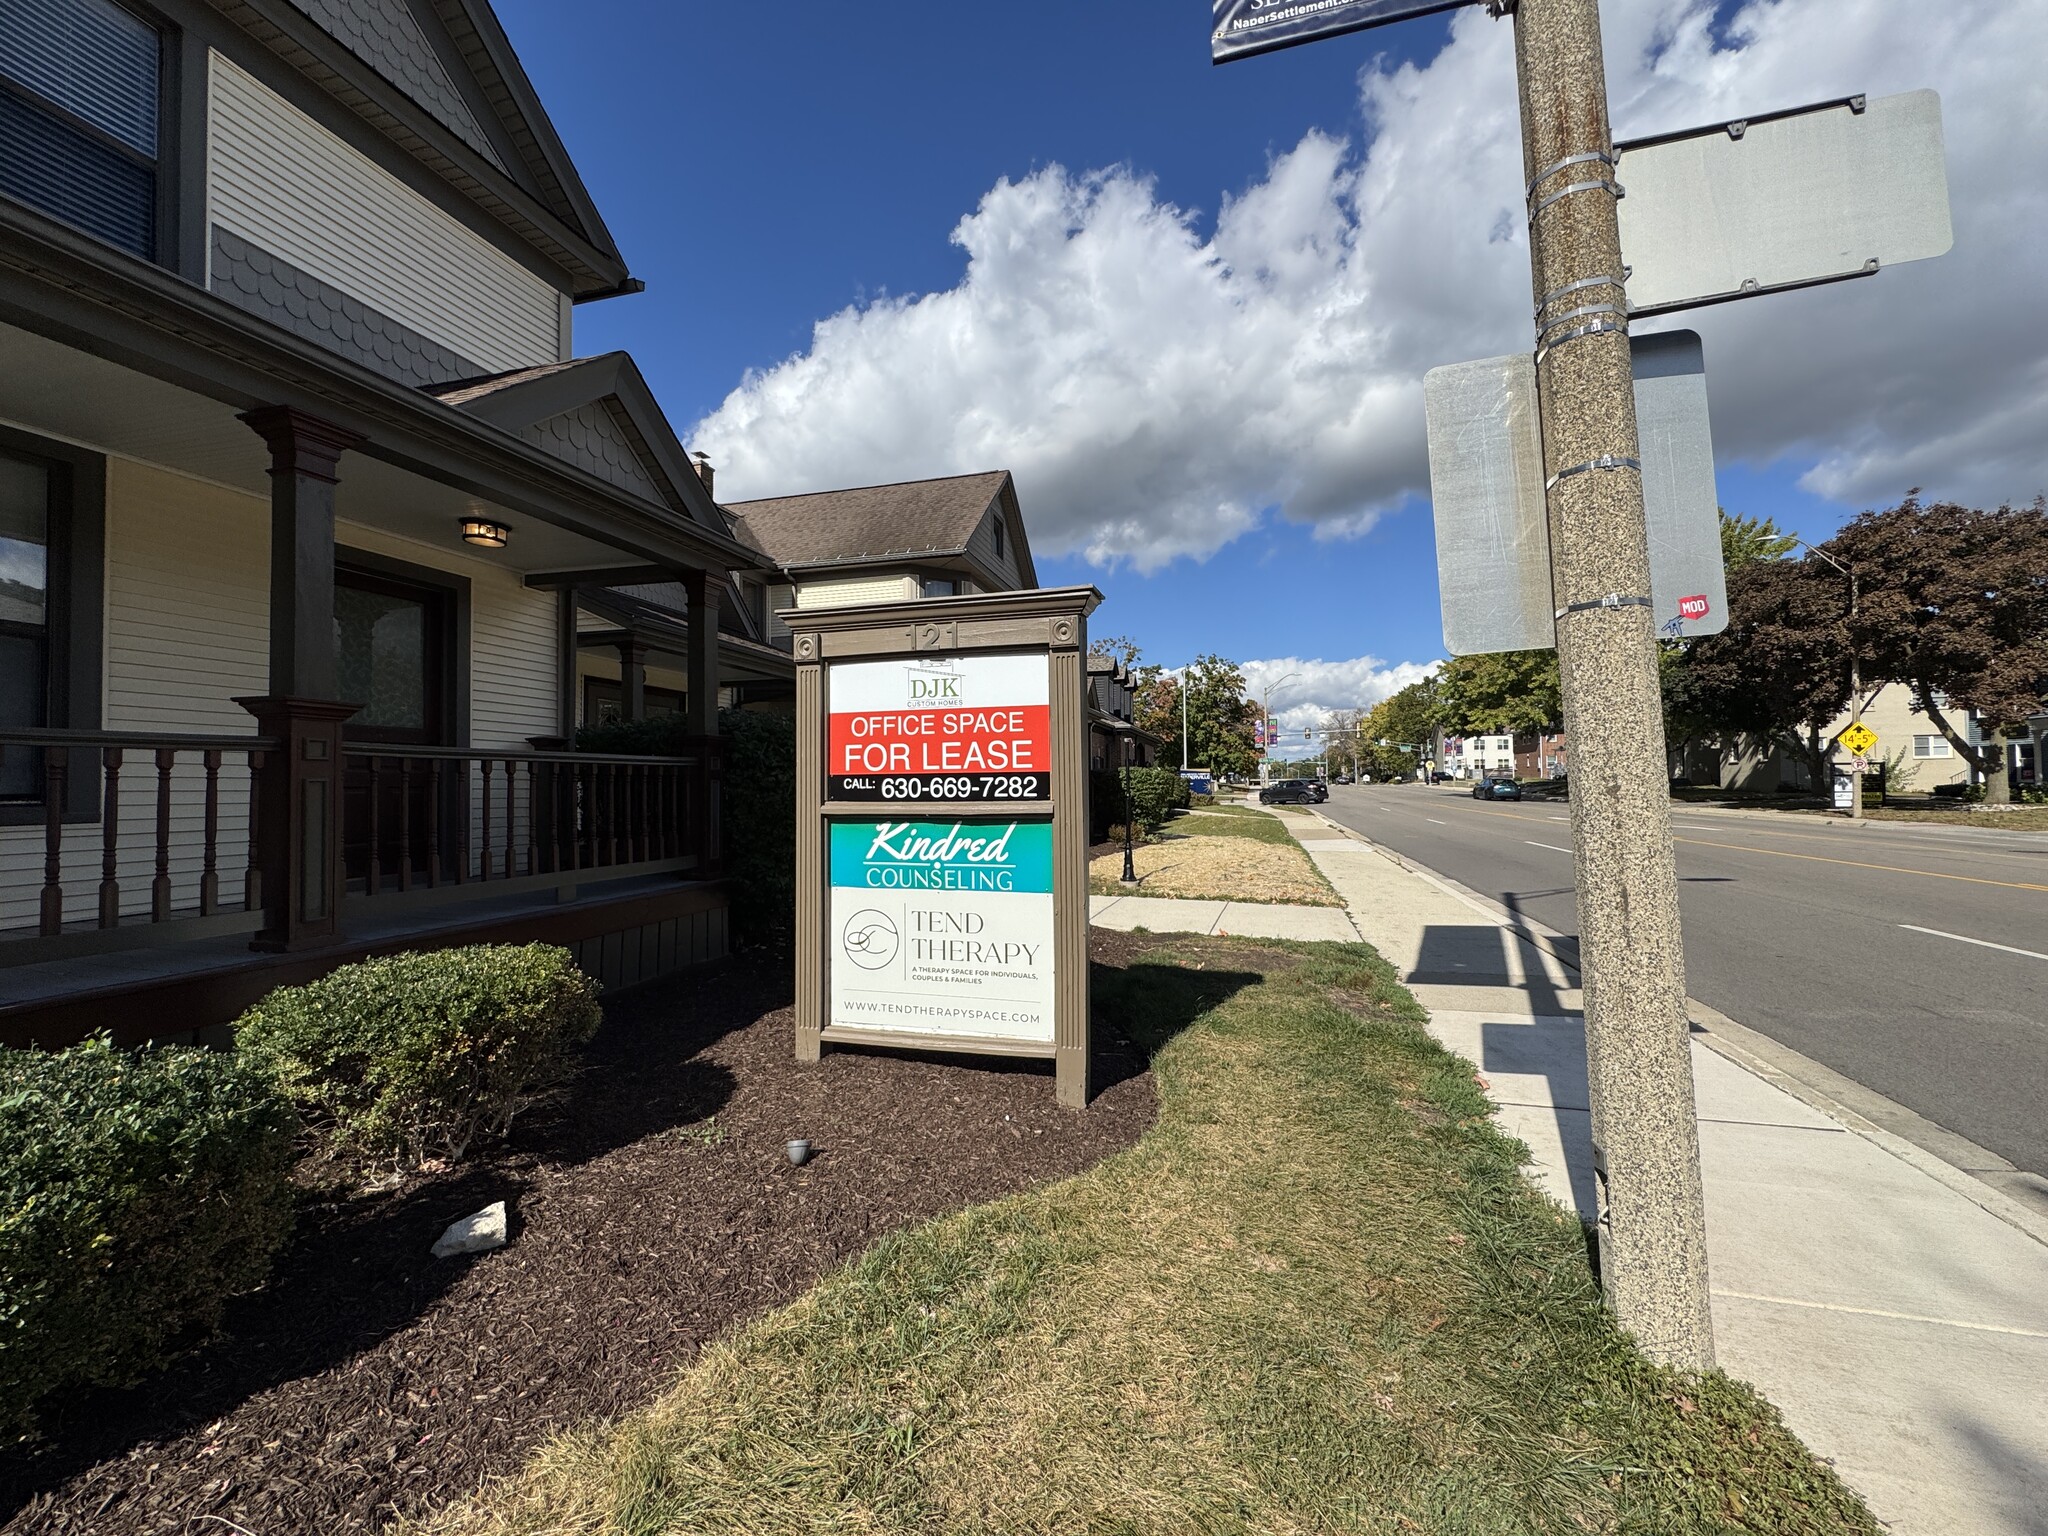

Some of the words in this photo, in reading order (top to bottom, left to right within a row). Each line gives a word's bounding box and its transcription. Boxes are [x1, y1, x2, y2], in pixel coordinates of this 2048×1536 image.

[1682, 599, 1706, 614] MOD
[906, 621, 958, 651] 121
[910, 677, 960, 699] DJK
[906, 700, 937, 708] CUSTOM
[938, 699, 963, 707] HOMES
[850, 714, 936, 738] OFFICE
[942, 711, 1025, 735] SPACE
[844, 743, 911, 772] FOR
[922, 740, 1033, 771] LEASE
[843, 778, 876, 790] CALL:
[881, 776, 1038, 799] 630-669-7282
[866, 820, 1018, 862] Kindred
[866, 867, 1014, 891] COUNSELING
[911, 910, 984, 935] TEND
[911, 938, 1040, 965] THERAPY
[912, 974, 944, 982] COUPLES
[951, 976, 983, 985] FAMILIES
[919, 966, 951, 974] THERAPY
[951, 967, 974, 976] SPACE
[975, 969, 990, 977] FOR
[990, 970, 1039, 980] INDIVIDUALS,
[843, 1000, 1040, 1023] WWW.TENDTHERAPYSPACE.COM
